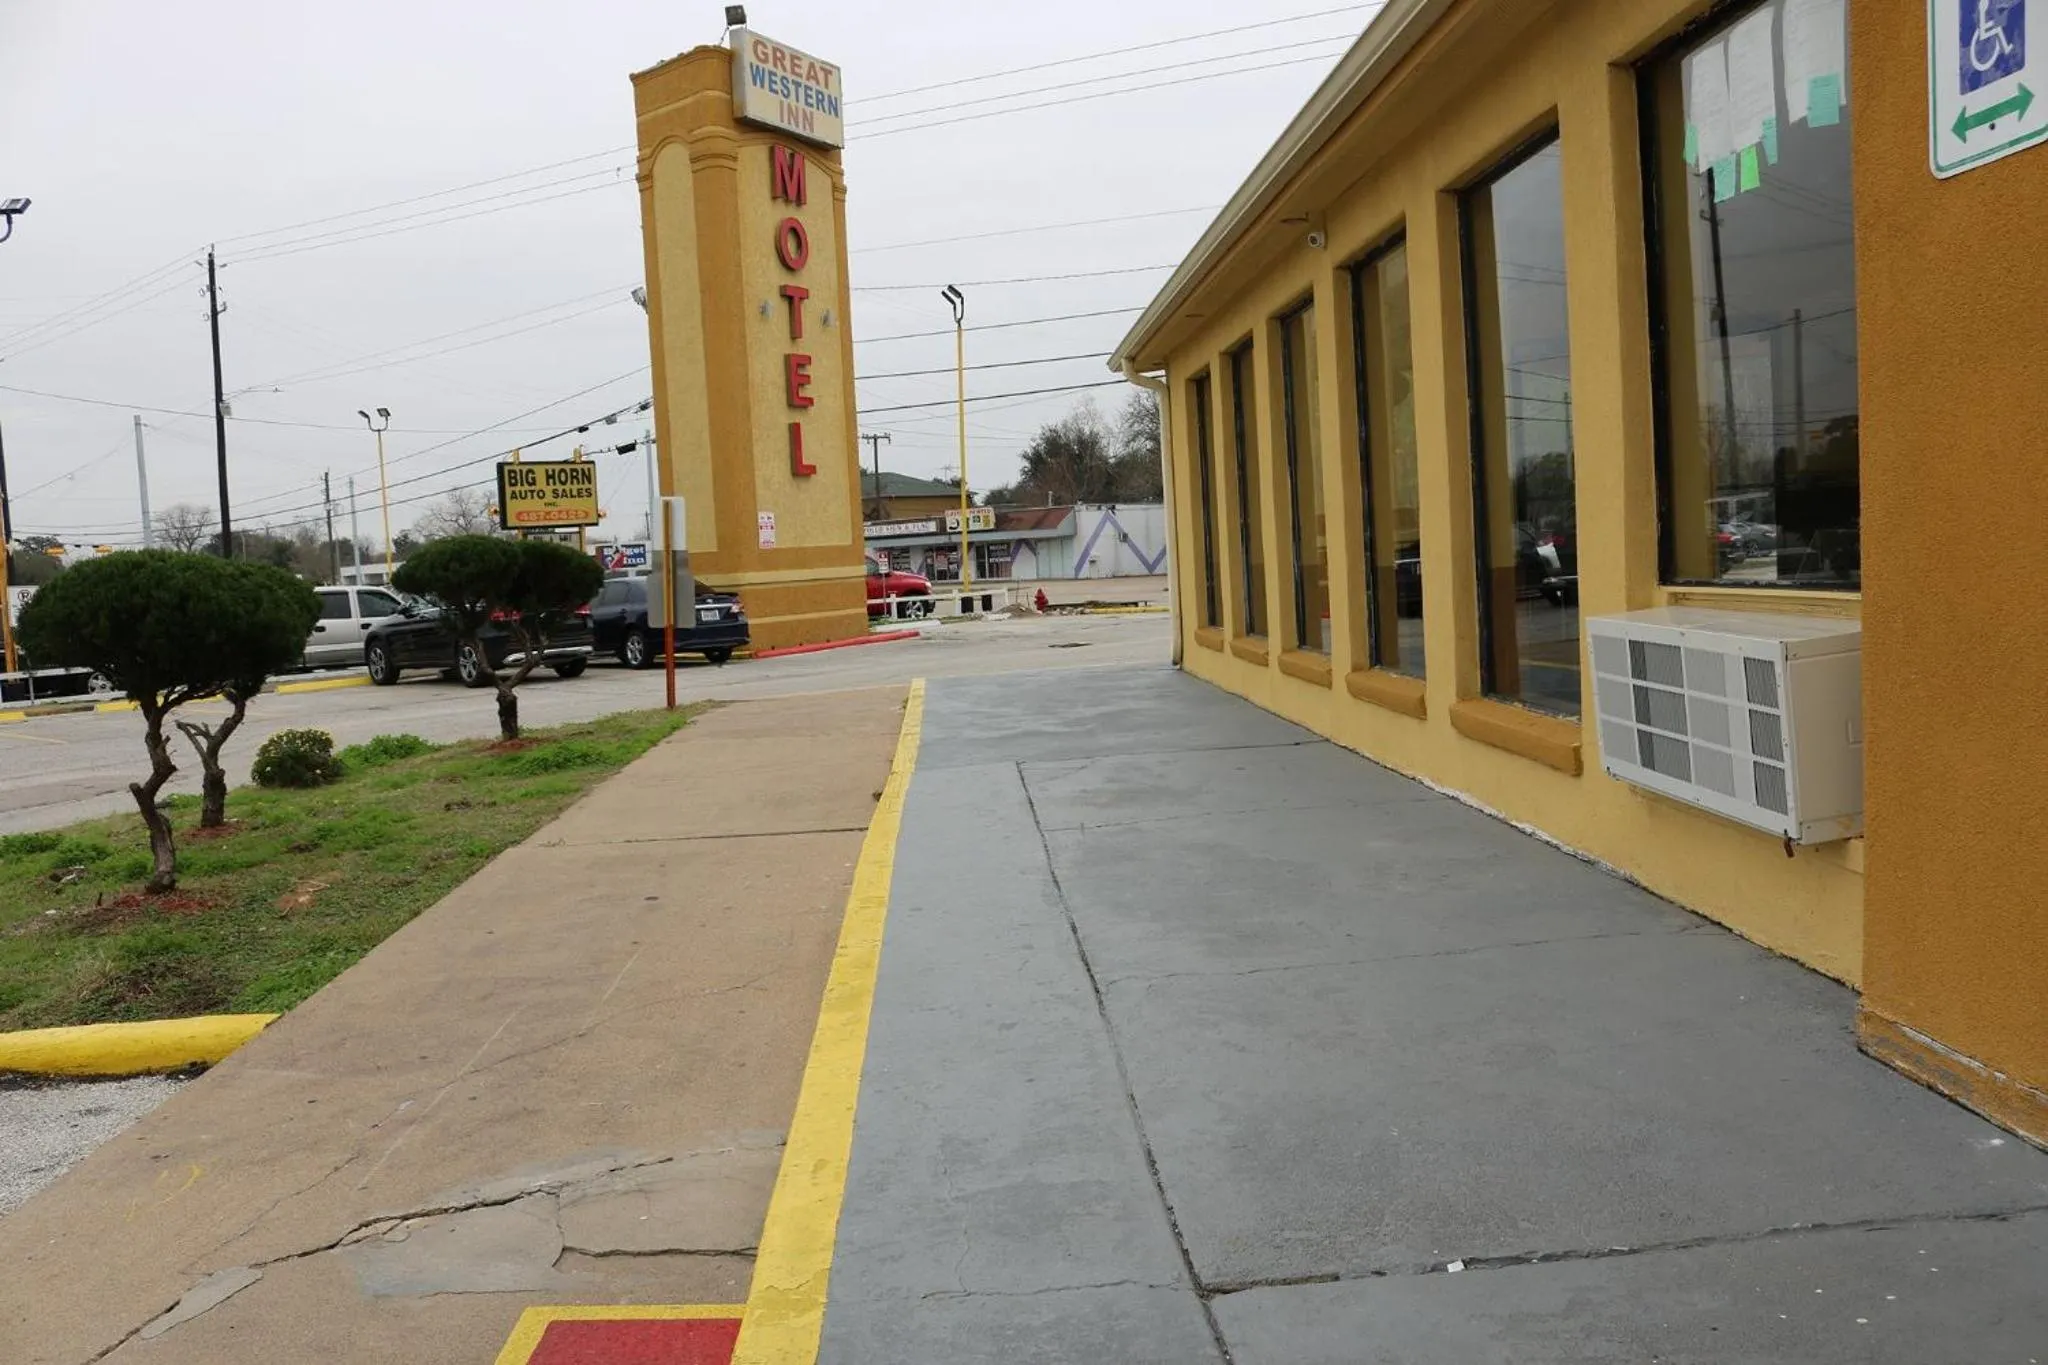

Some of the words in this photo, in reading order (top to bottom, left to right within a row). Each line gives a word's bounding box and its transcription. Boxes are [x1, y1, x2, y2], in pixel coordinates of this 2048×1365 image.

[752, 38, 833, 91] GREAT
[749, 62, 839, 118] WESTERN
[778, 99, 815, 133] INN
[771, 143, 817, 477] MOTEL
[507, 468, 536, 487] BIG
[545, 467, 592, 487] HORN
[510, 488, 546, 500] AUTO
[551, 487, 592, 498] SALES
